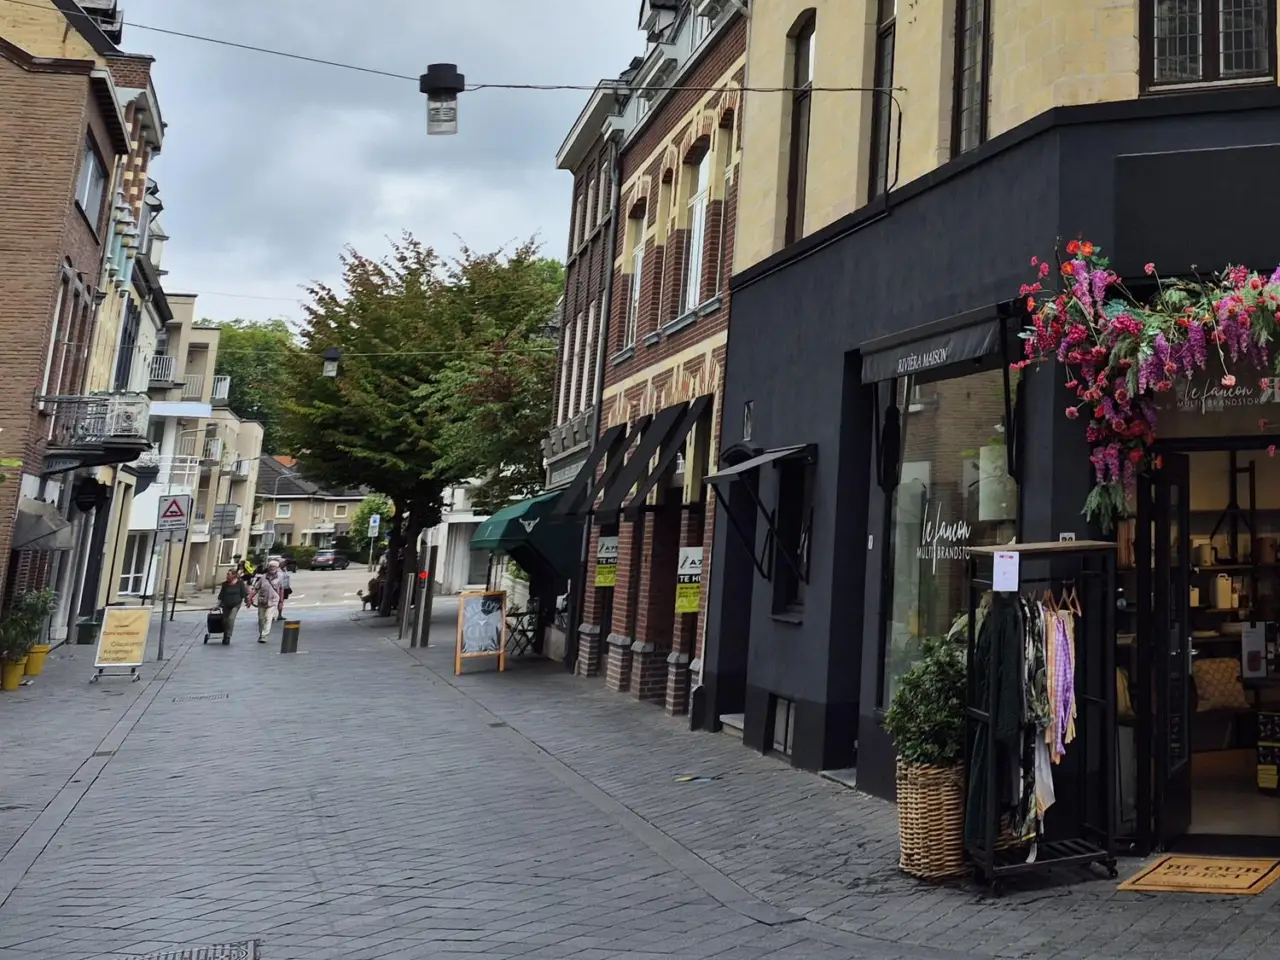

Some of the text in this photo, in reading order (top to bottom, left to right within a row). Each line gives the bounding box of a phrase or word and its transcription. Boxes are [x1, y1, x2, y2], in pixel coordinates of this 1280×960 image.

[922, 347, 948, 367] MAISON
[916, 546, 934, 559] MULTI
[679, 575, 701, 583] TE H
[1204, 866, 1261, 874] OUR
